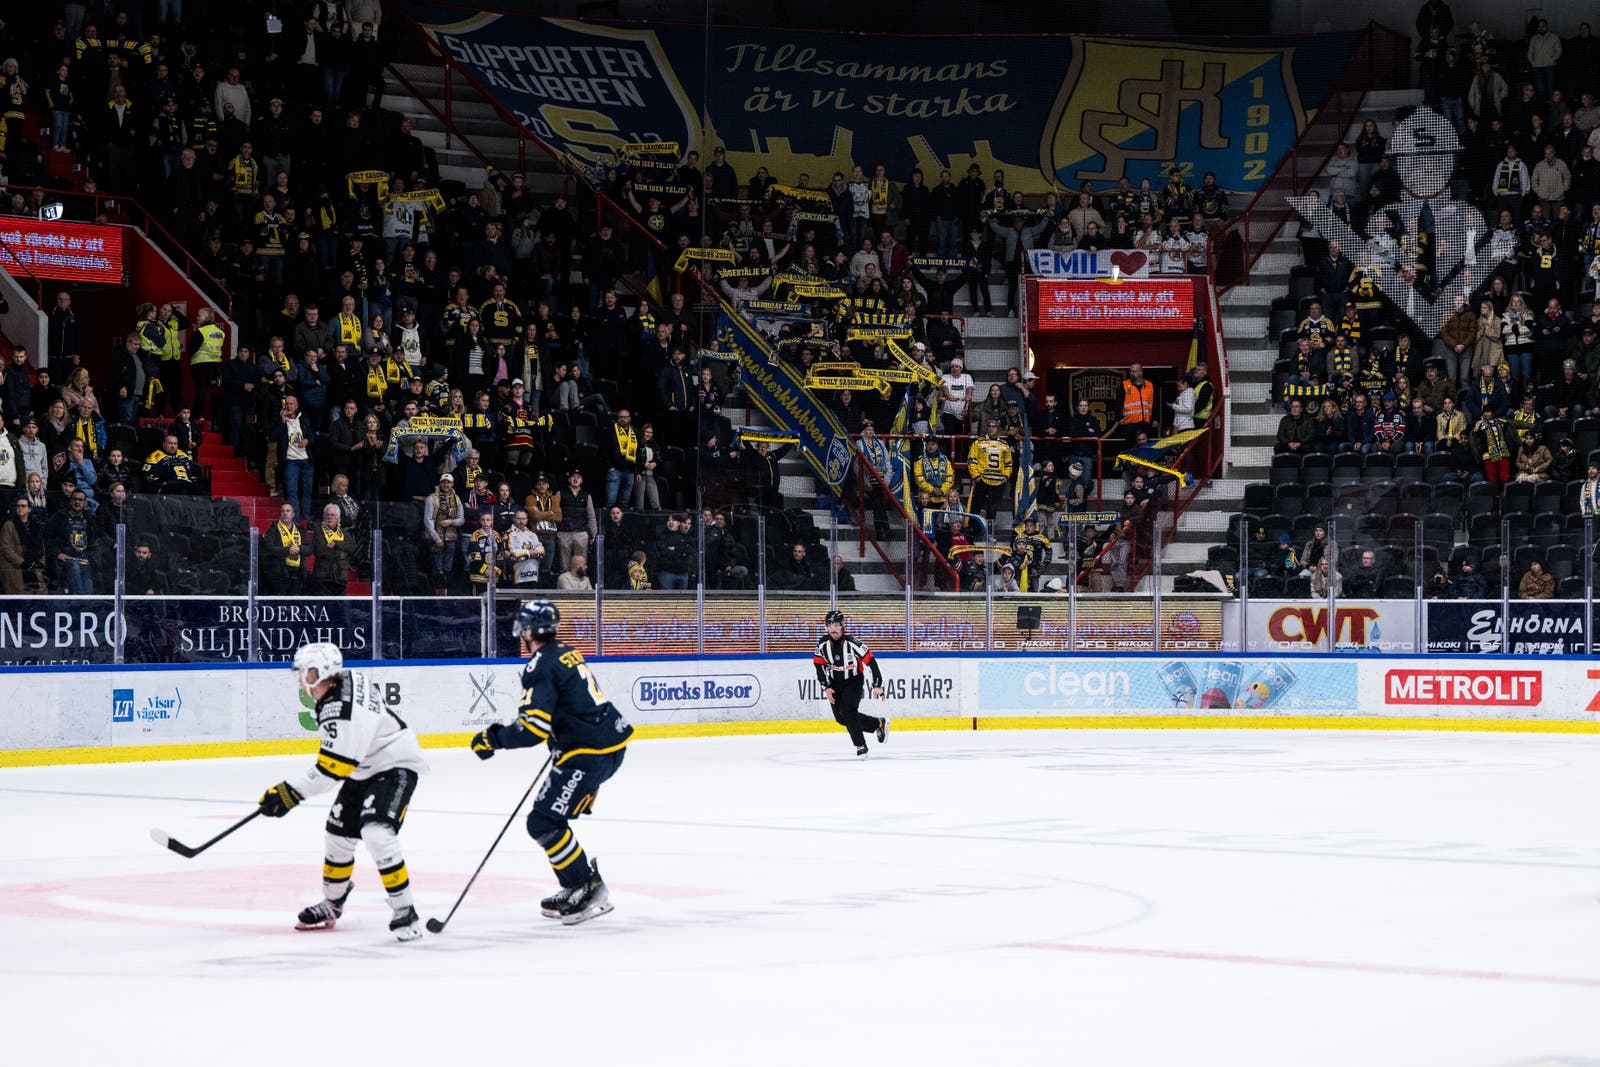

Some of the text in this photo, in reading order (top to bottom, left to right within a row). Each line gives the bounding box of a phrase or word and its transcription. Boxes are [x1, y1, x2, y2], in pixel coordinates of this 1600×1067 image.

[442, 35, 652, 79] SUPPORTER
[724, 43, 1009, 82] Tillsammans
[477, 67, 647, 108] KLUBBEN
[744, 86, 1017, 119] är vi starka
[1242, 76, 1270, 181] 1902
[24, 231, 65, 248] värdet
[86, 237, 104, 251] att
[1033, 252, 1108, 274] EMIL
[1053, 289, 1174, 303] Vi vet värdet av att
[1048, 305, 1184, 321] spela på hemmaplan.
[1073, 375, 1121, 391] SUPPORTER
[1267, 605, 1381, 646] CWT
[181, 626, 367, 658] SILJENDAHLS
[911, 674, 953, 699] HÄR?
[1024, 664, 1130, 696] clean
[1390, 675, 1537, 700] METROLIT
[147, 696, 176, 709] Visar
[640, 680, 753, 706] Björcks Resor
[113, 700, 133, 718] LT
[136, 707, 170, 721] vägen.
